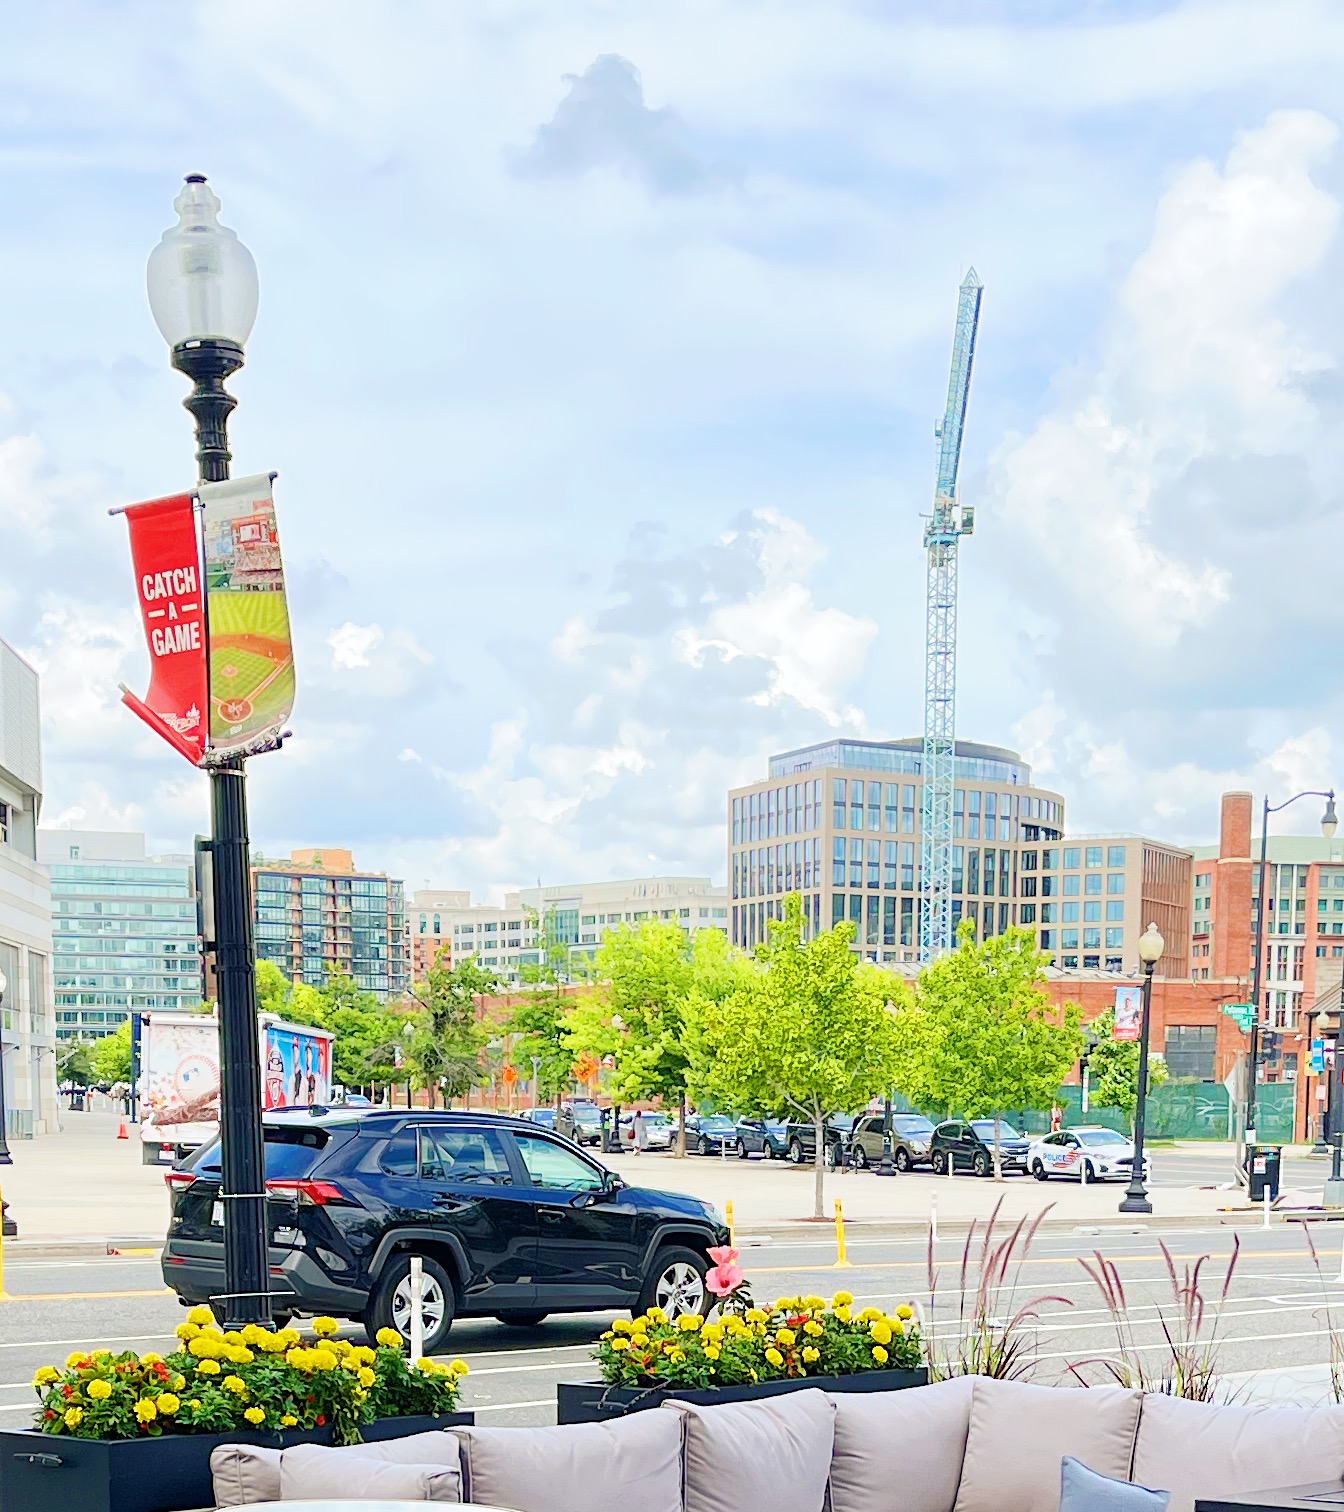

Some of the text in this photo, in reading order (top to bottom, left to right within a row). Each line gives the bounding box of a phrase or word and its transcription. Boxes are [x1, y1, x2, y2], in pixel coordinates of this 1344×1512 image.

[142, 566, 197, 601] CATCH
[168, 602, 178, 620] A
[151, 621, 201, 656] GAME
